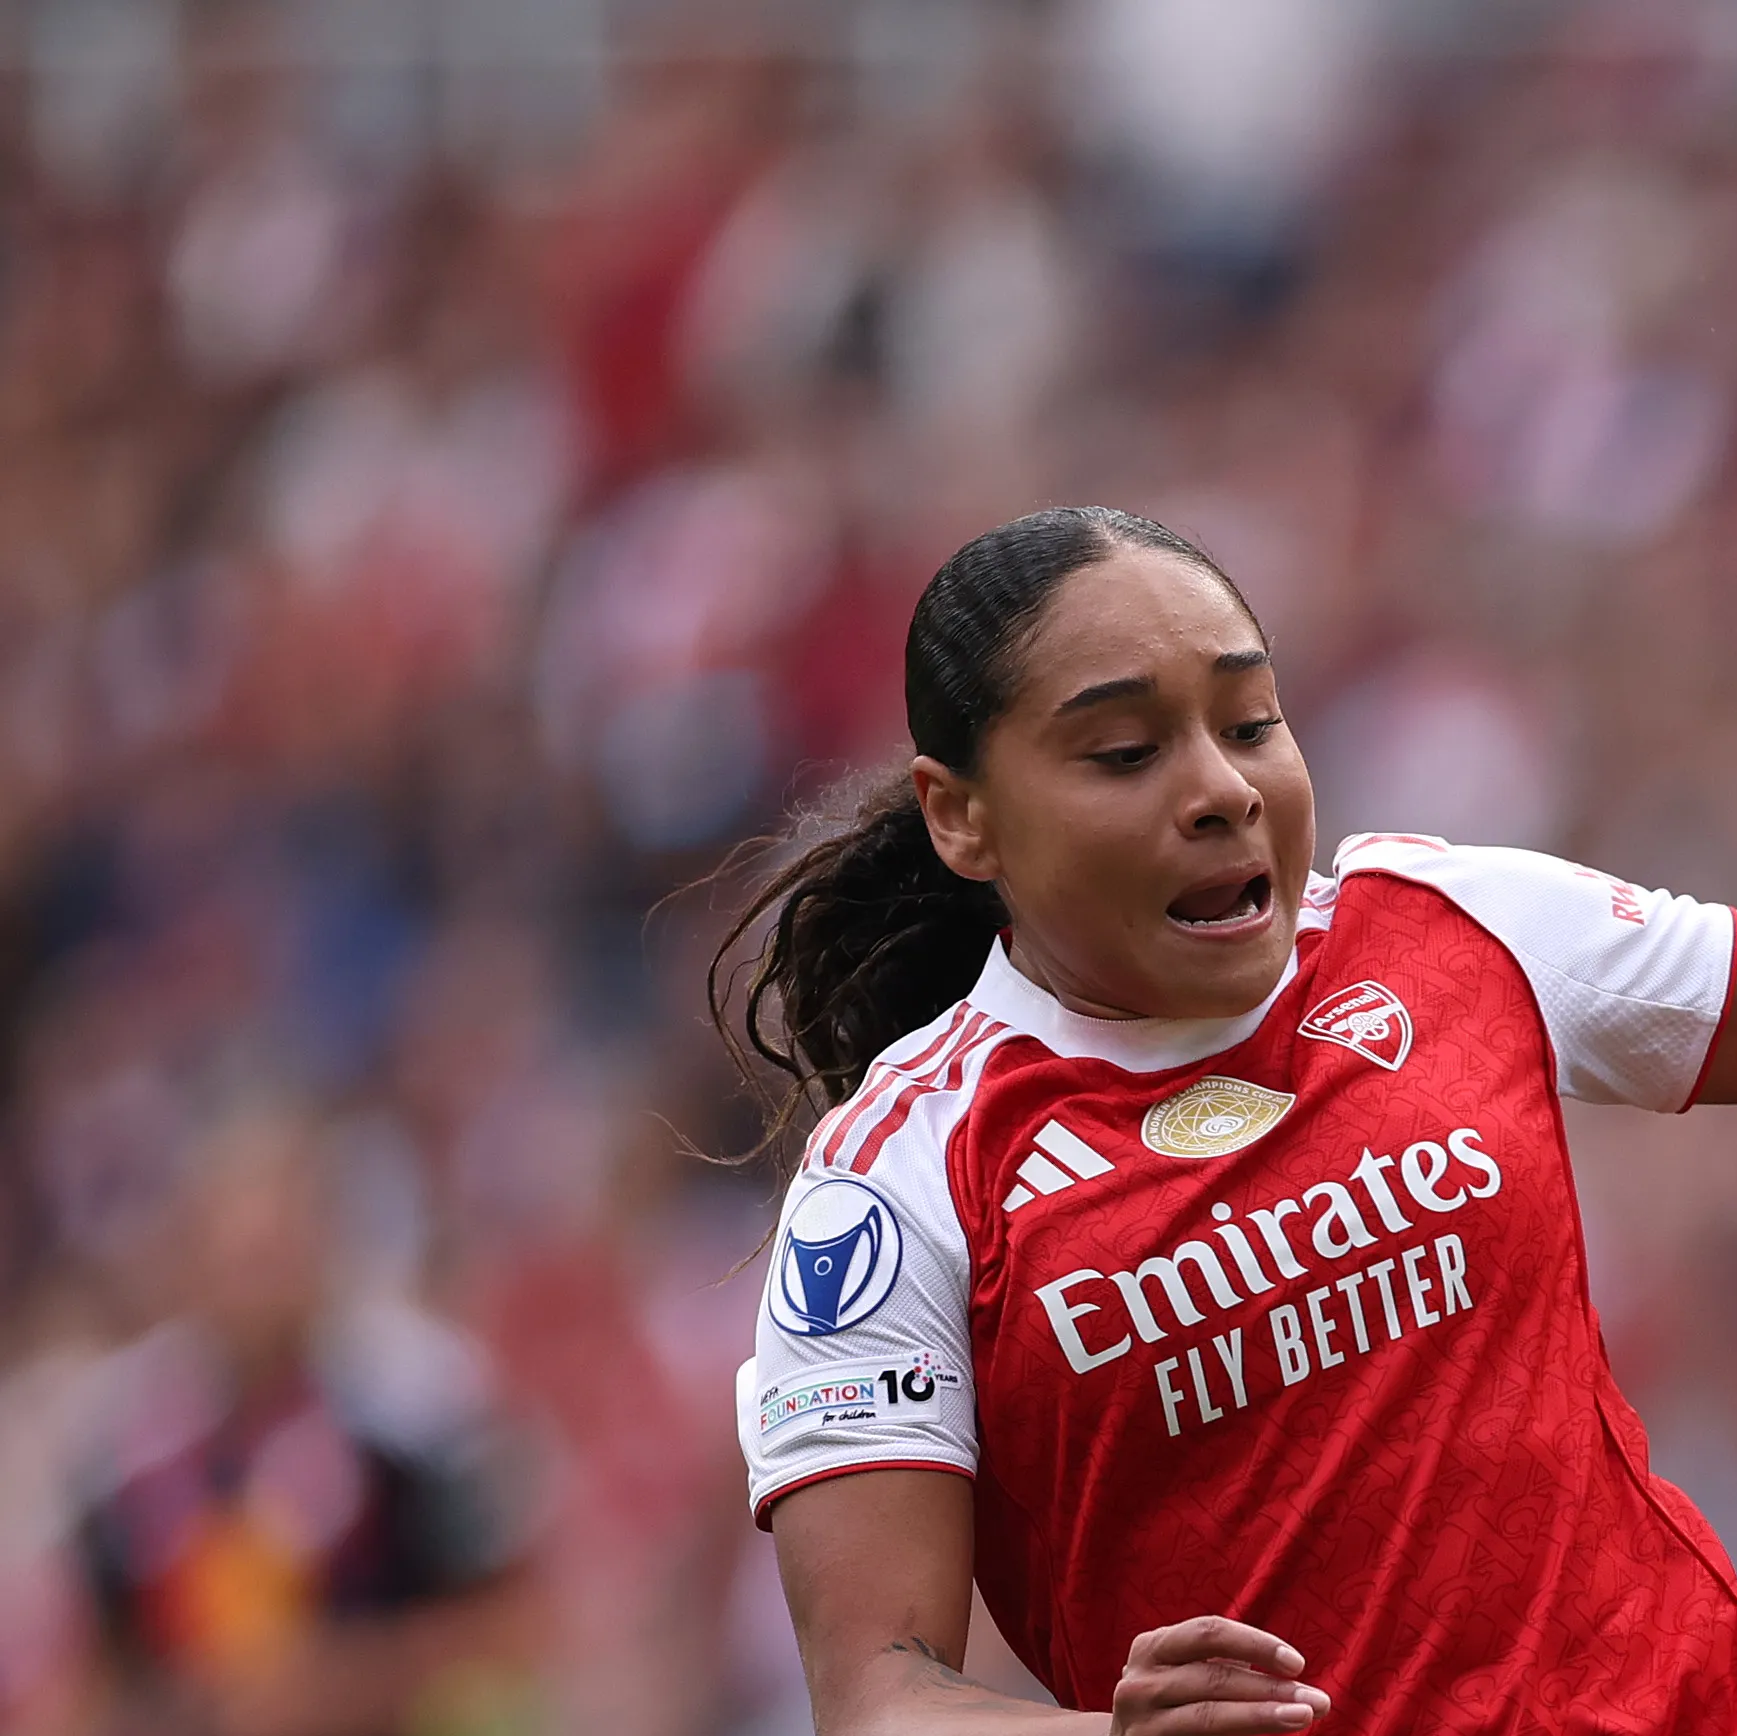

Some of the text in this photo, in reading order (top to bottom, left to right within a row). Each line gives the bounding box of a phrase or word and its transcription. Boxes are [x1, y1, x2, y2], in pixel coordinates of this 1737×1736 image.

[1313, 990, 1380, 1028] Arsenal
[1034, 1128, 1501, 1375] Emirates
[878, 1368, 935, 1404] 10
[1154, 1234, 1474, 1437] FLY BETTER
